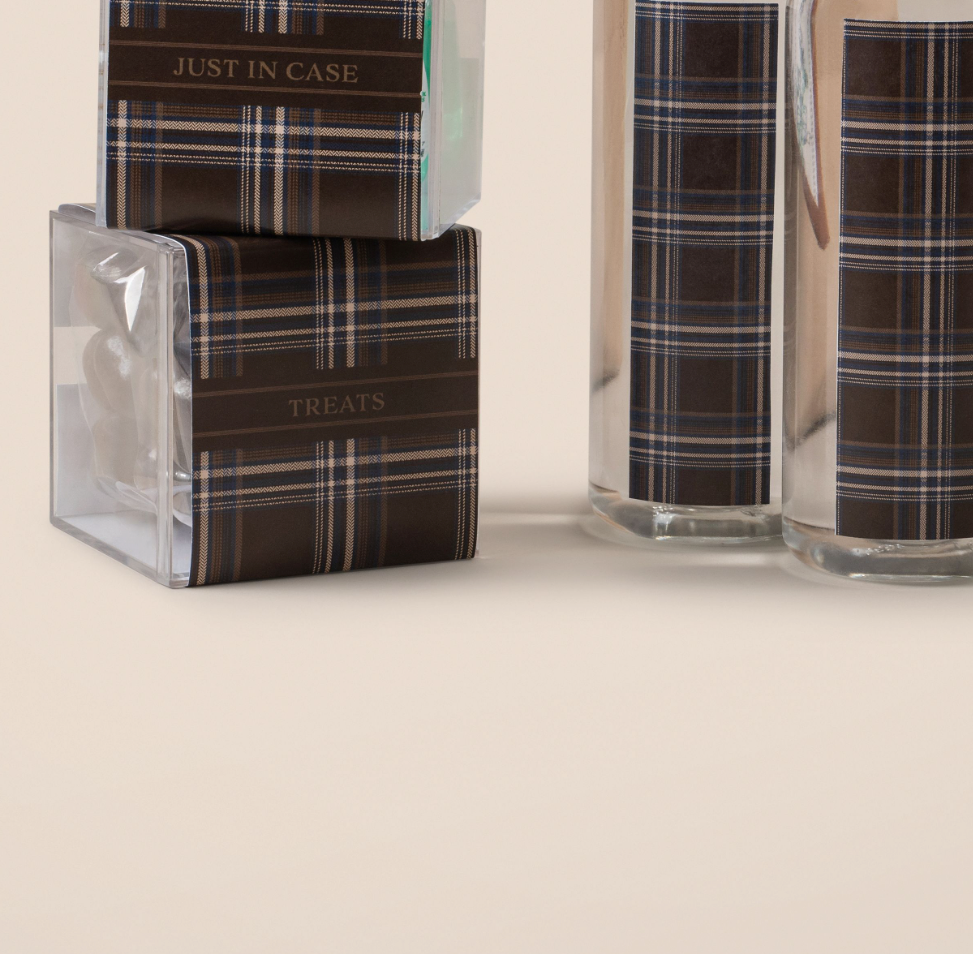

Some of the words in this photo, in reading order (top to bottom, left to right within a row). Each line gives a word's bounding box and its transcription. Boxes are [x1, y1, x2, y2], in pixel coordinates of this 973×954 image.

[173, 57, 240, 78] JUST
[247, 60, 279, 80] IN
[286, 62, 359, 83] CASE
[288, 392, 386, 417] TREATS
